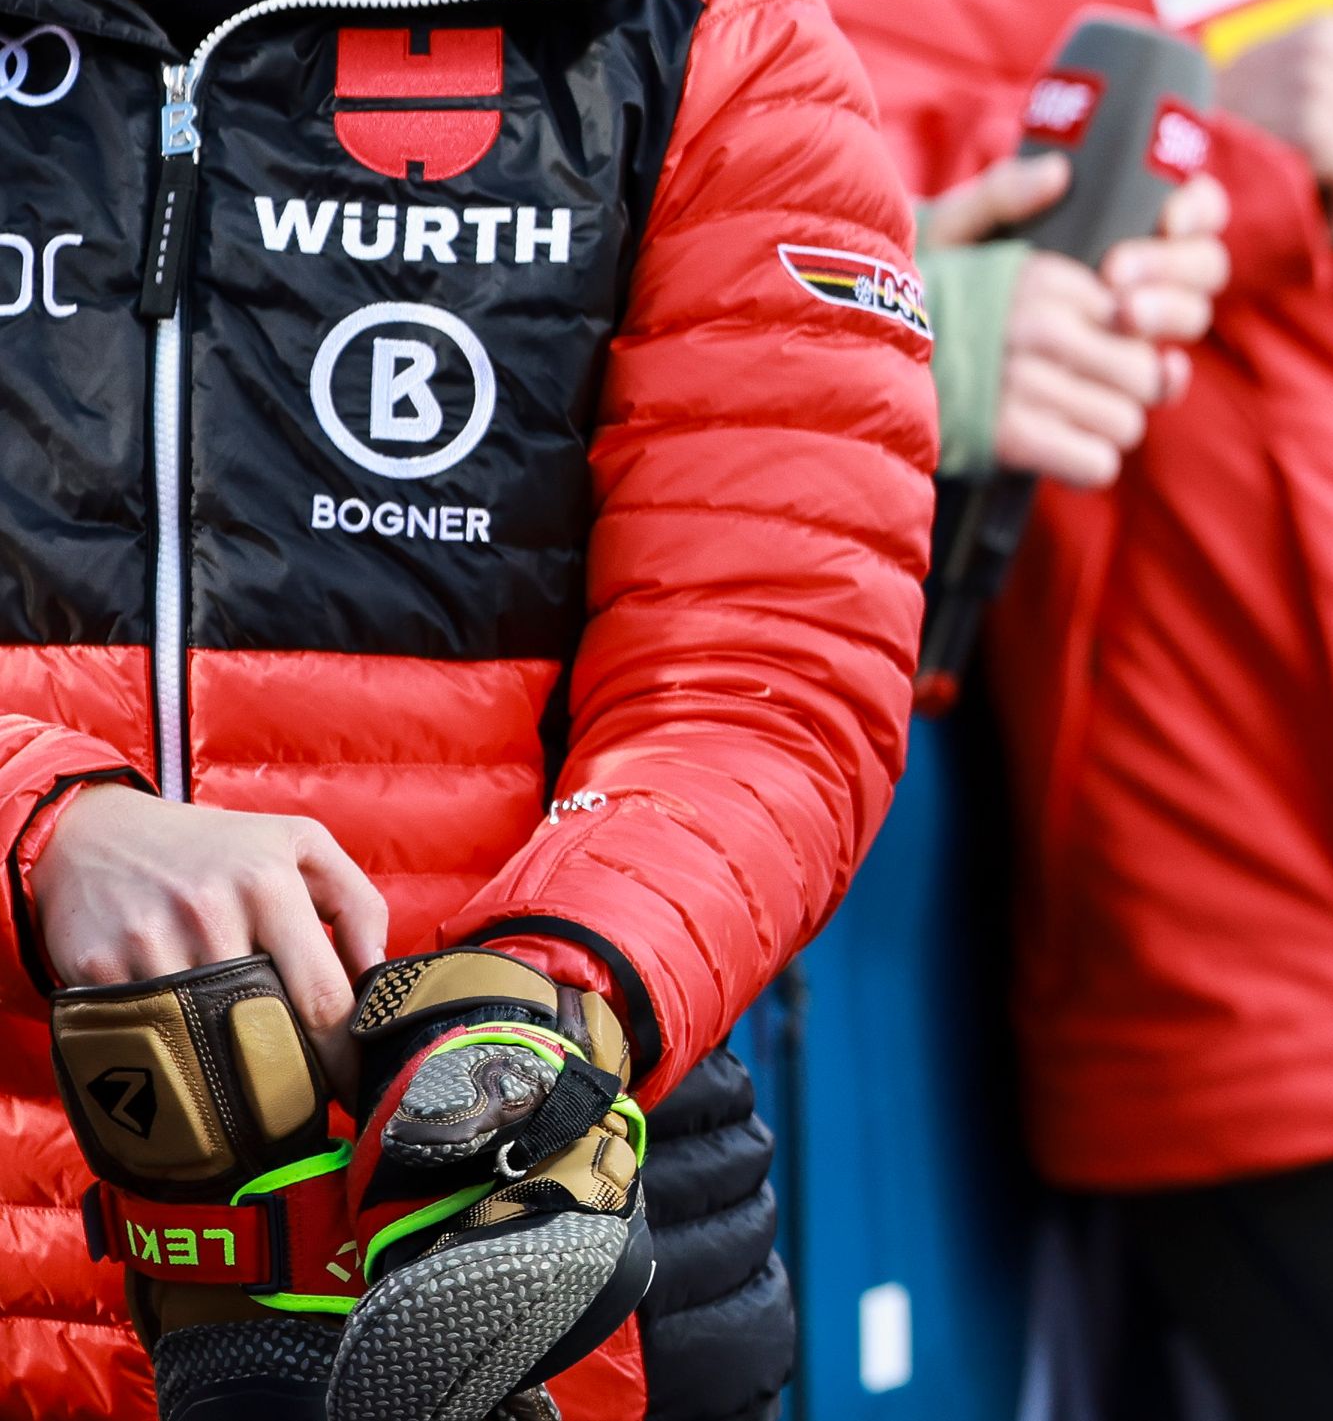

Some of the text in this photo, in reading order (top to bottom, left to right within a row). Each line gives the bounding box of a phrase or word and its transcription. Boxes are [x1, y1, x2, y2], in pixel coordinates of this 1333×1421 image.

[254, 196, 573, 265] WÜRTH
[311, 494, 492, 544] BOGNER
[127, 1220, 236, 1266] LEKI
